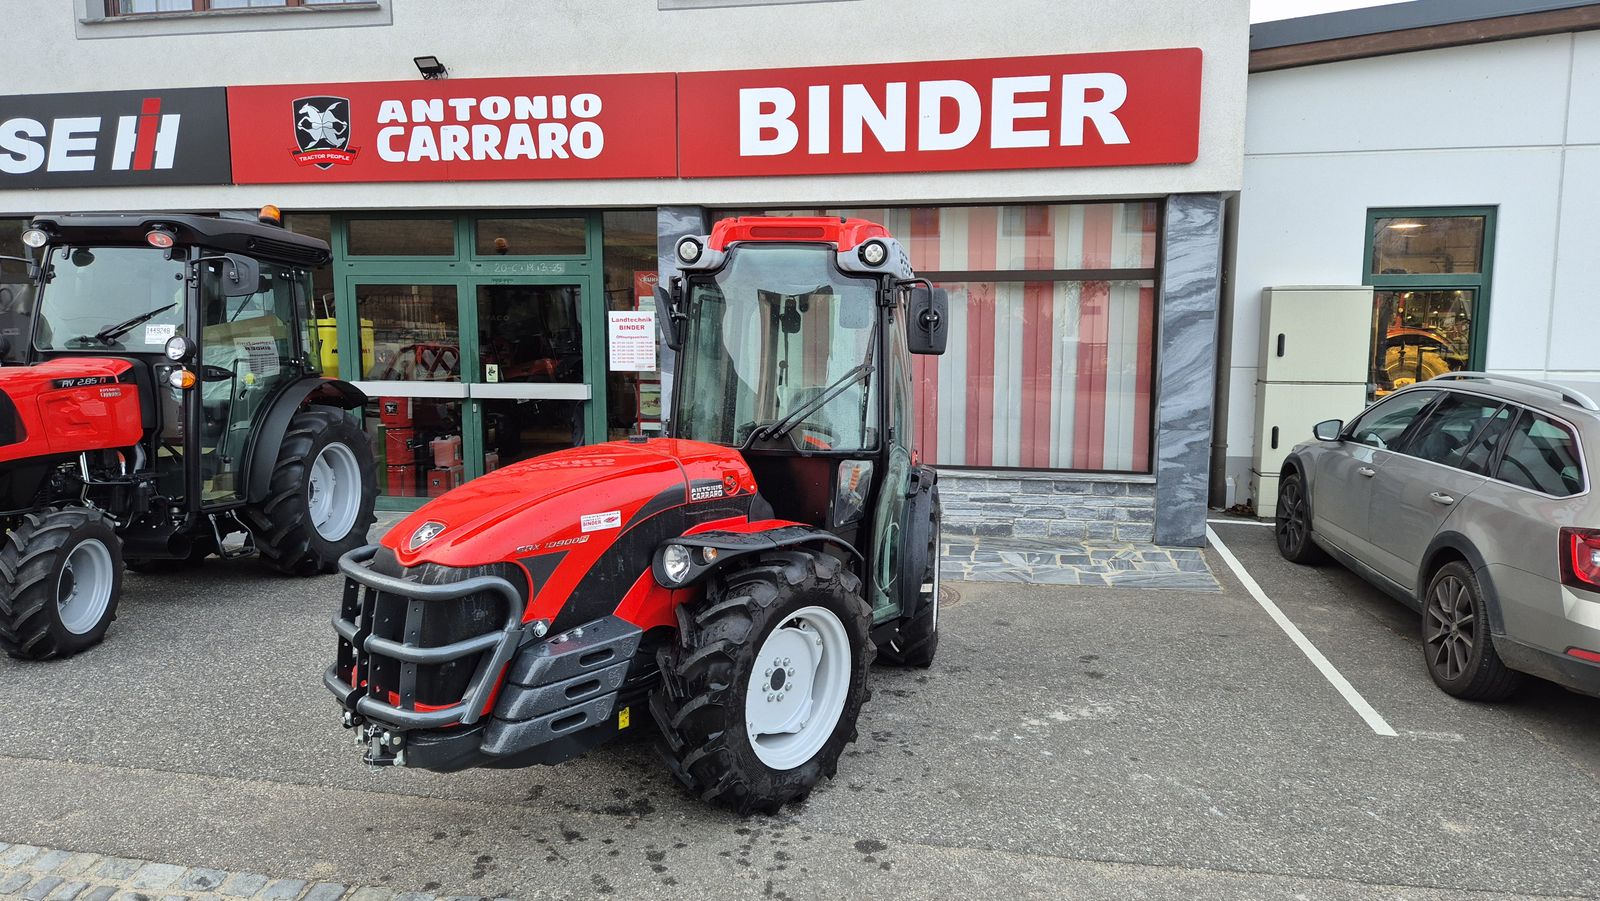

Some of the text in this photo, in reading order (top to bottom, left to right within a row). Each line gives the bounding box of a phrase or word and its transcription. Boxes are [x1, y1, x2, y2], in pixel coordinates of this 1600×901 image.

[377, 93, 603, 124] ANTONIO
[739, 72, 1131, 157] BINDER
[376, 121, 605, 163] CARRARO
[299, 153, 350, 162] TRACTOR PEOPLE
[77, 377, 97, 386] 2.85
[691, 484, 723, 494] ANTONIO
[691, 489, 723, 501] CARRARO
